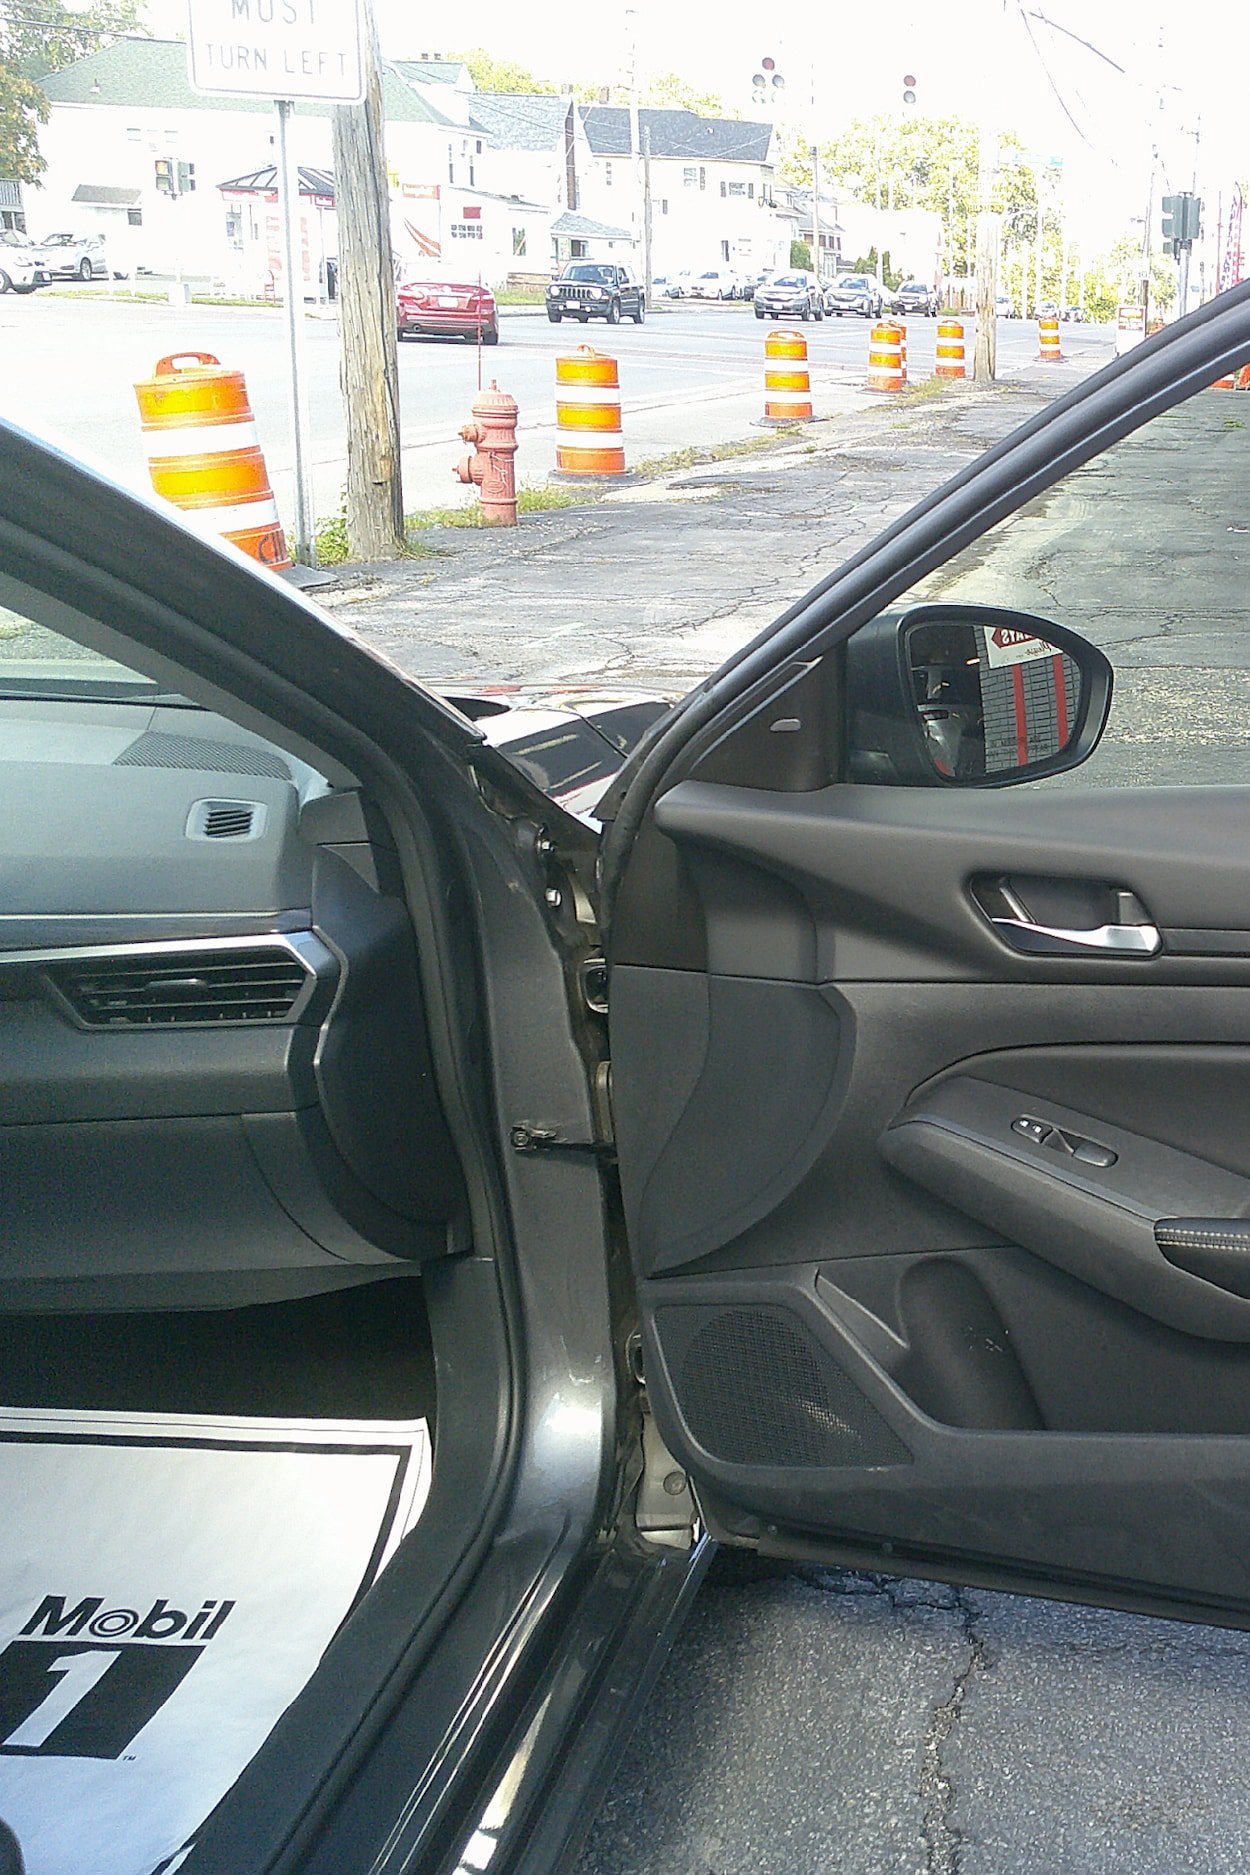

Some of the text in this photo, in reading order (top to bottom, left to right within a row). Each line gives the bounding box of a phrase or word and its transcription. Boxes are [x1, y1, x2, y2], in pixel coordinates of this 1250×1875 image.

[206, 44, 347, 76] TURN LEFT
[17, 1595, 238, 1641] Mobil
[1, 1650, 123, 1748] 1
